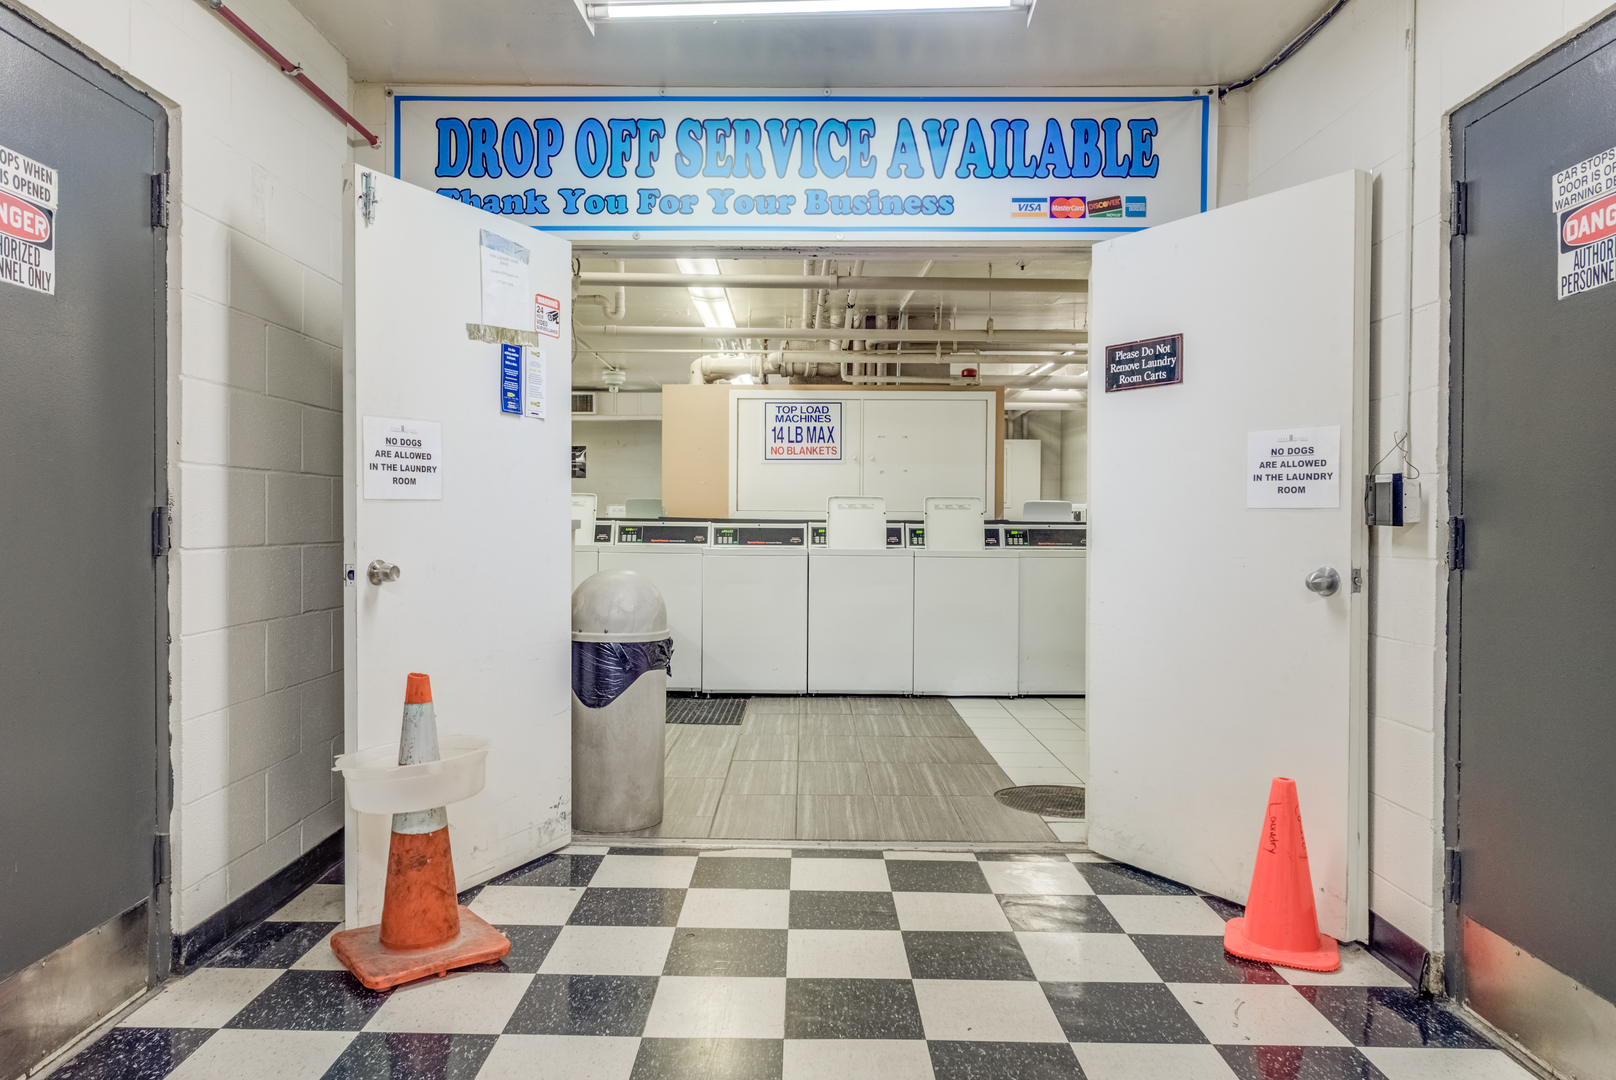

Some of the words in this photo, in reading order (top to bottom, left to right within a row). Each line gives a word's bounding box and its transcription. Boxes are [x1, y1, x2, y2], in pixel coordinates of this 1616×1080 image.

[434, 117, 564, 179] DROP
[575, 117, 666, 179] OFF
[675, 117, 877, 179] SERVICE
[886, 117, 1160, 179] AVAILABLE
[23, 159, 52, 185] WHEN
[1557, 166, 1578, 184] CAR
[1580, 148, 1615, 174] STOPS
[13, 174, 51, 202] OPENED
[1559, 174, 1588, 196] DOOR
[1591, 169, 1601, 183] IS
[557, 188, 628, 215] You
[636, 188, 699, 215] For
[707, 188, 796, 215] Your
[804, 188, 954, 215] Business
[1555, 182, 1602, 211] WARNING
[1018, 203, 1042, 212] VISA
[1051, 204, 1085, 212] MasterCard
[1088, 198, 1121, 211] DISCOVER
[1566, 203, 1616, 242] DANG
[28, 266, 51, 292] ONLY
[1561, 260, 1616, 296] PERSONNE
[536, 305, 544, 314] 24
[1115, 351, 1139, 361] Please
[1141, 347, 1154, 356] Do
[1156, 344, 1170, 354] Not
[1110, 363, 1140, 373] Remove
[1141, 356, 1177, 369] Laundry
[1119, 374, 1142, 385] Room
[1144, 371, 1166, 380] Carts
[776, 406, 797, 414] TOP
[801, 406, 829, 414] LOAD
[775, 414, 831, 423] MACHINES
[772, 426, 785, 443] 14
[788, 426, 803, 443] LB
[807, 426, 835, 443] MAX
[385, 437, 398, 445] NO
[400, 438, 422, 447] DOGS
[375, 450, 391, 458] ARE
[394, 451, 432, 460] ALLOWED
[770, 446, 785, 455] NO
[786, 446, 838, 455] BLANKETS
[1287, 446, 1314, 455] DOGS
[369, 463, 378, 471] IN
[381, 463, 398, 471] THE
[400, 464, 437, 473] LAUNDRY
[1280, 459, 1327, 468] ALLOWED
[392, 477, 416, 485] ROOM
[1265, 473, 1283, 481] THE
[1286, 472, 1333, 481] LAUNDRY
[1277, 486, 1306, 494] ROOM
